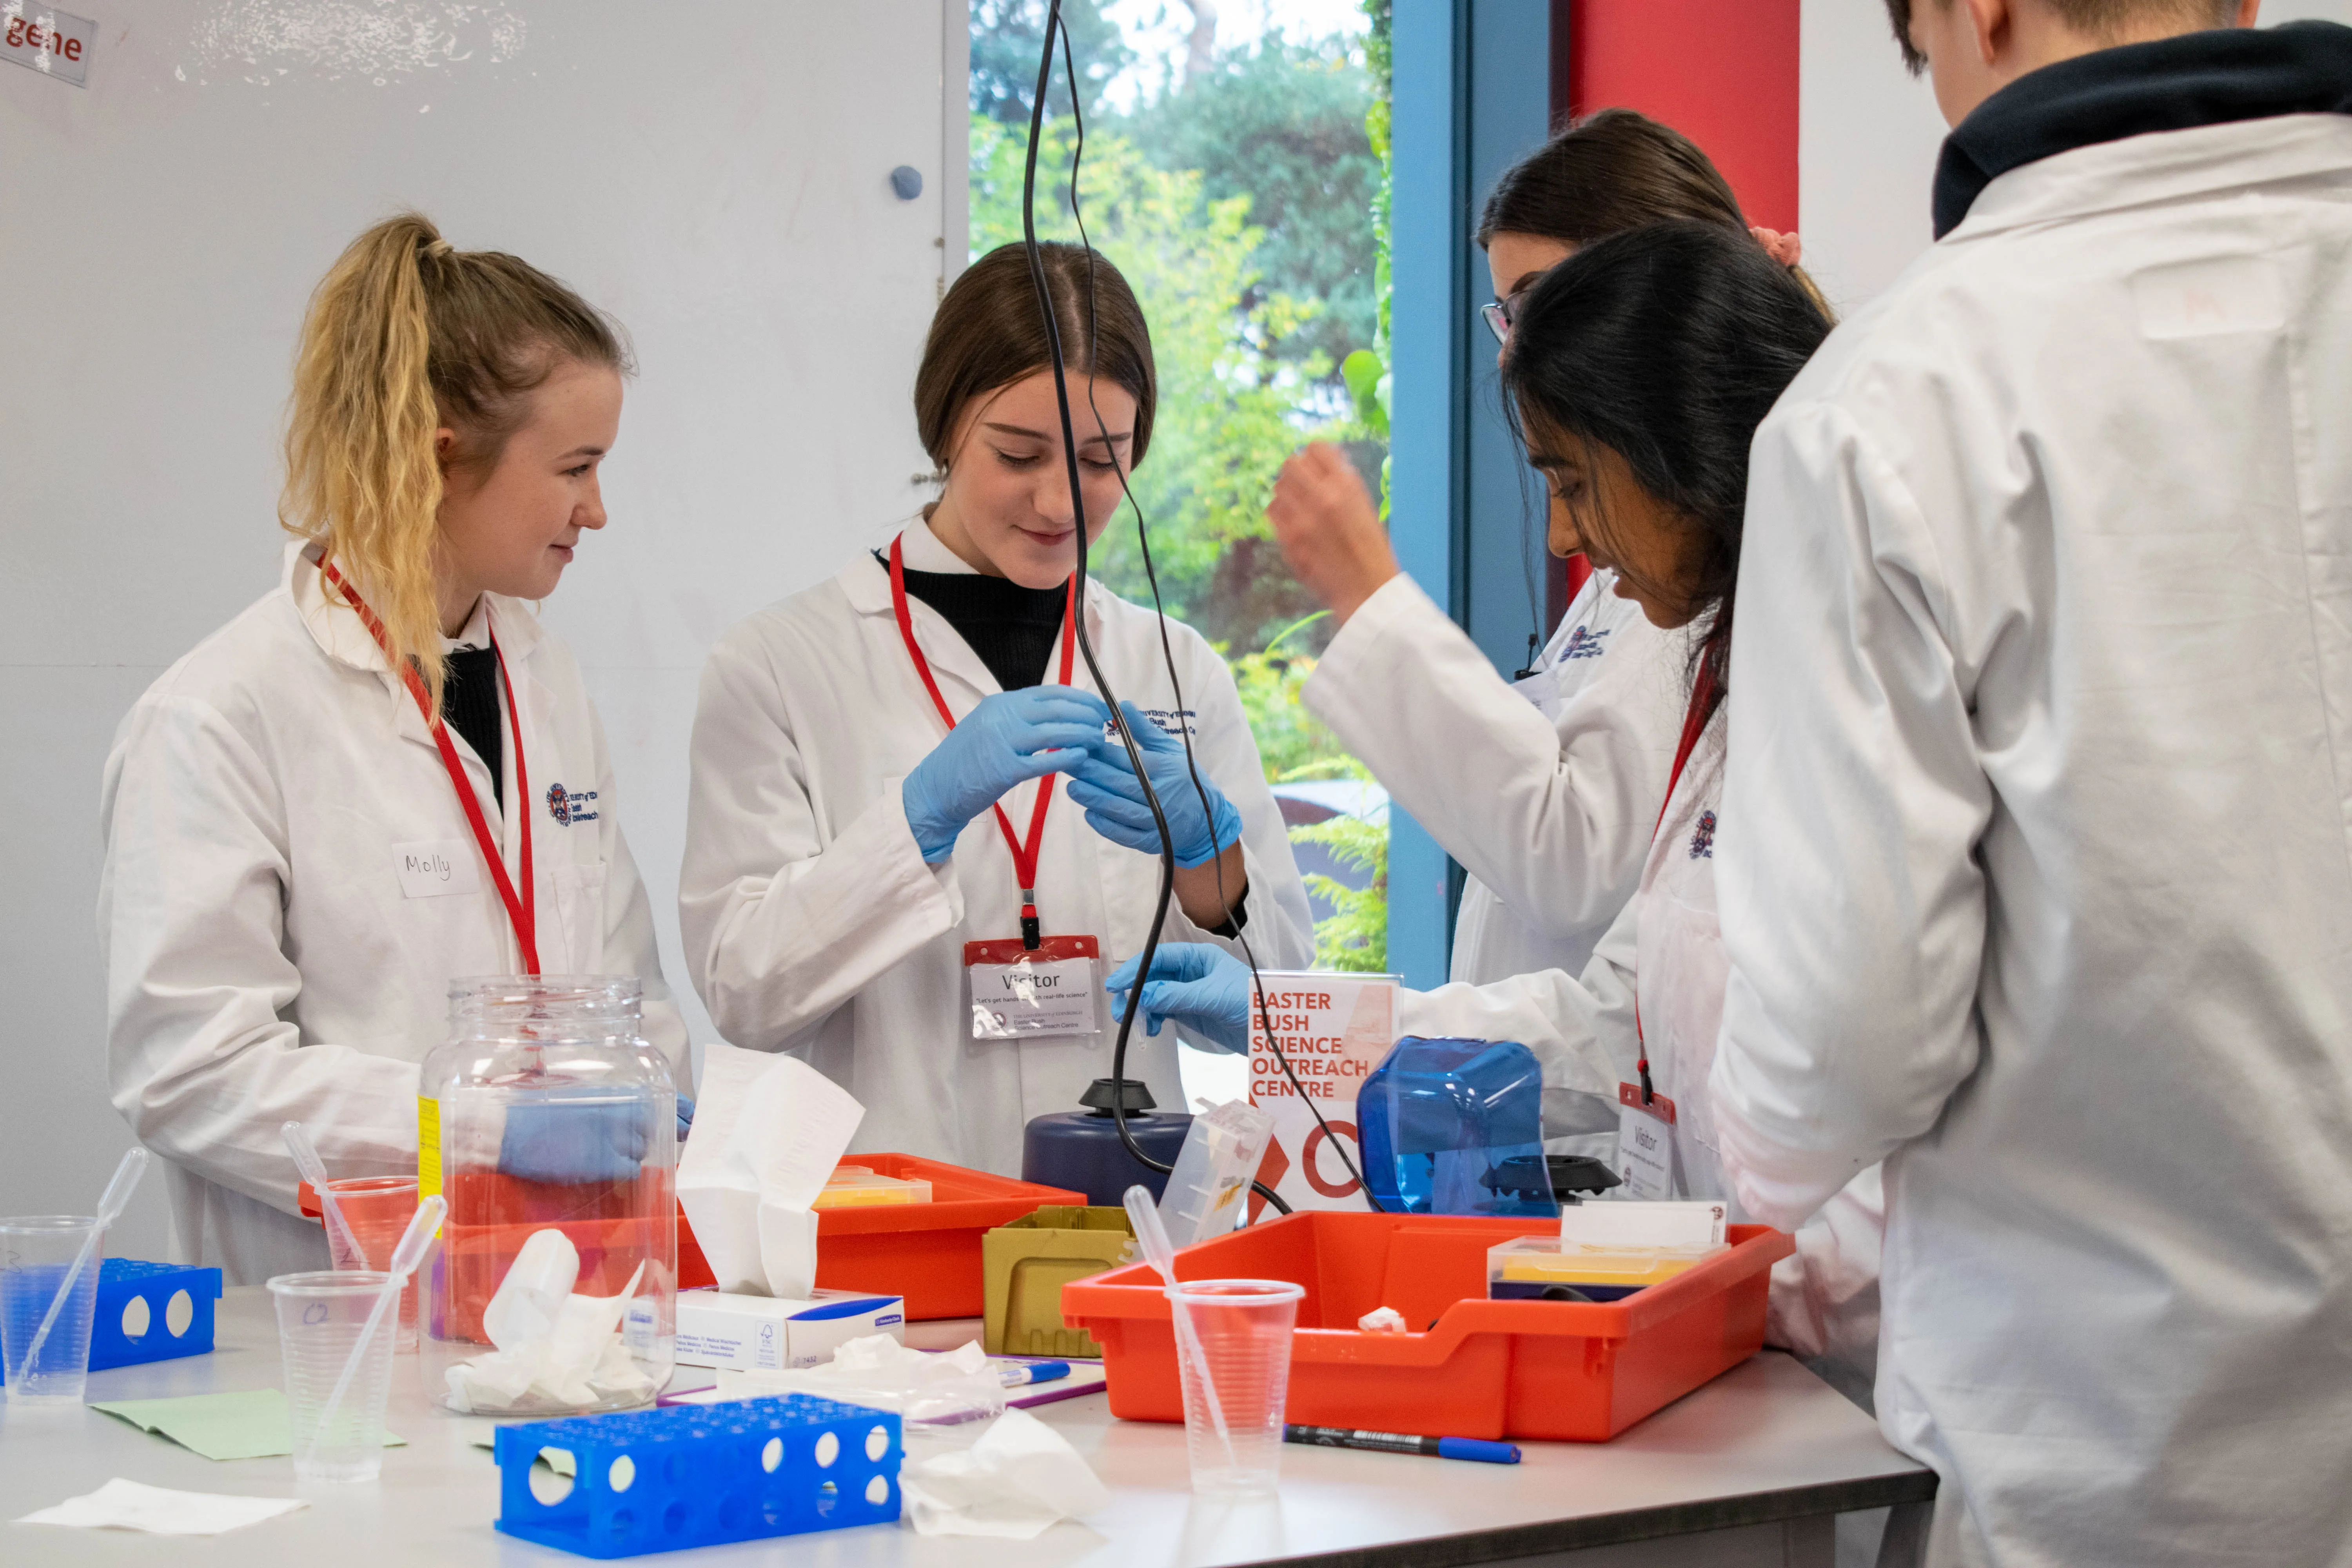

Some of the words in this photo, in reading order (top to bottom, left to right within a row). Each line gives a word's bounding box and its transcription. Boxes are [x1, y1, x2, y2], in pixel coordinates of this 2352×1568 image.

[6, 17, 82, 62] gene
[406, 855, 450, 881] Molly
[1253, 992, 1331, 1009] EASTER
[1252, 1014, 1308, 1031] BUSH
[1252, 1036, 1342, 1054] SCIENCE
[1252, 1058, 1368, 1076] OUTREACH
[1252, 1080, 1334, 1098] CENTRE
